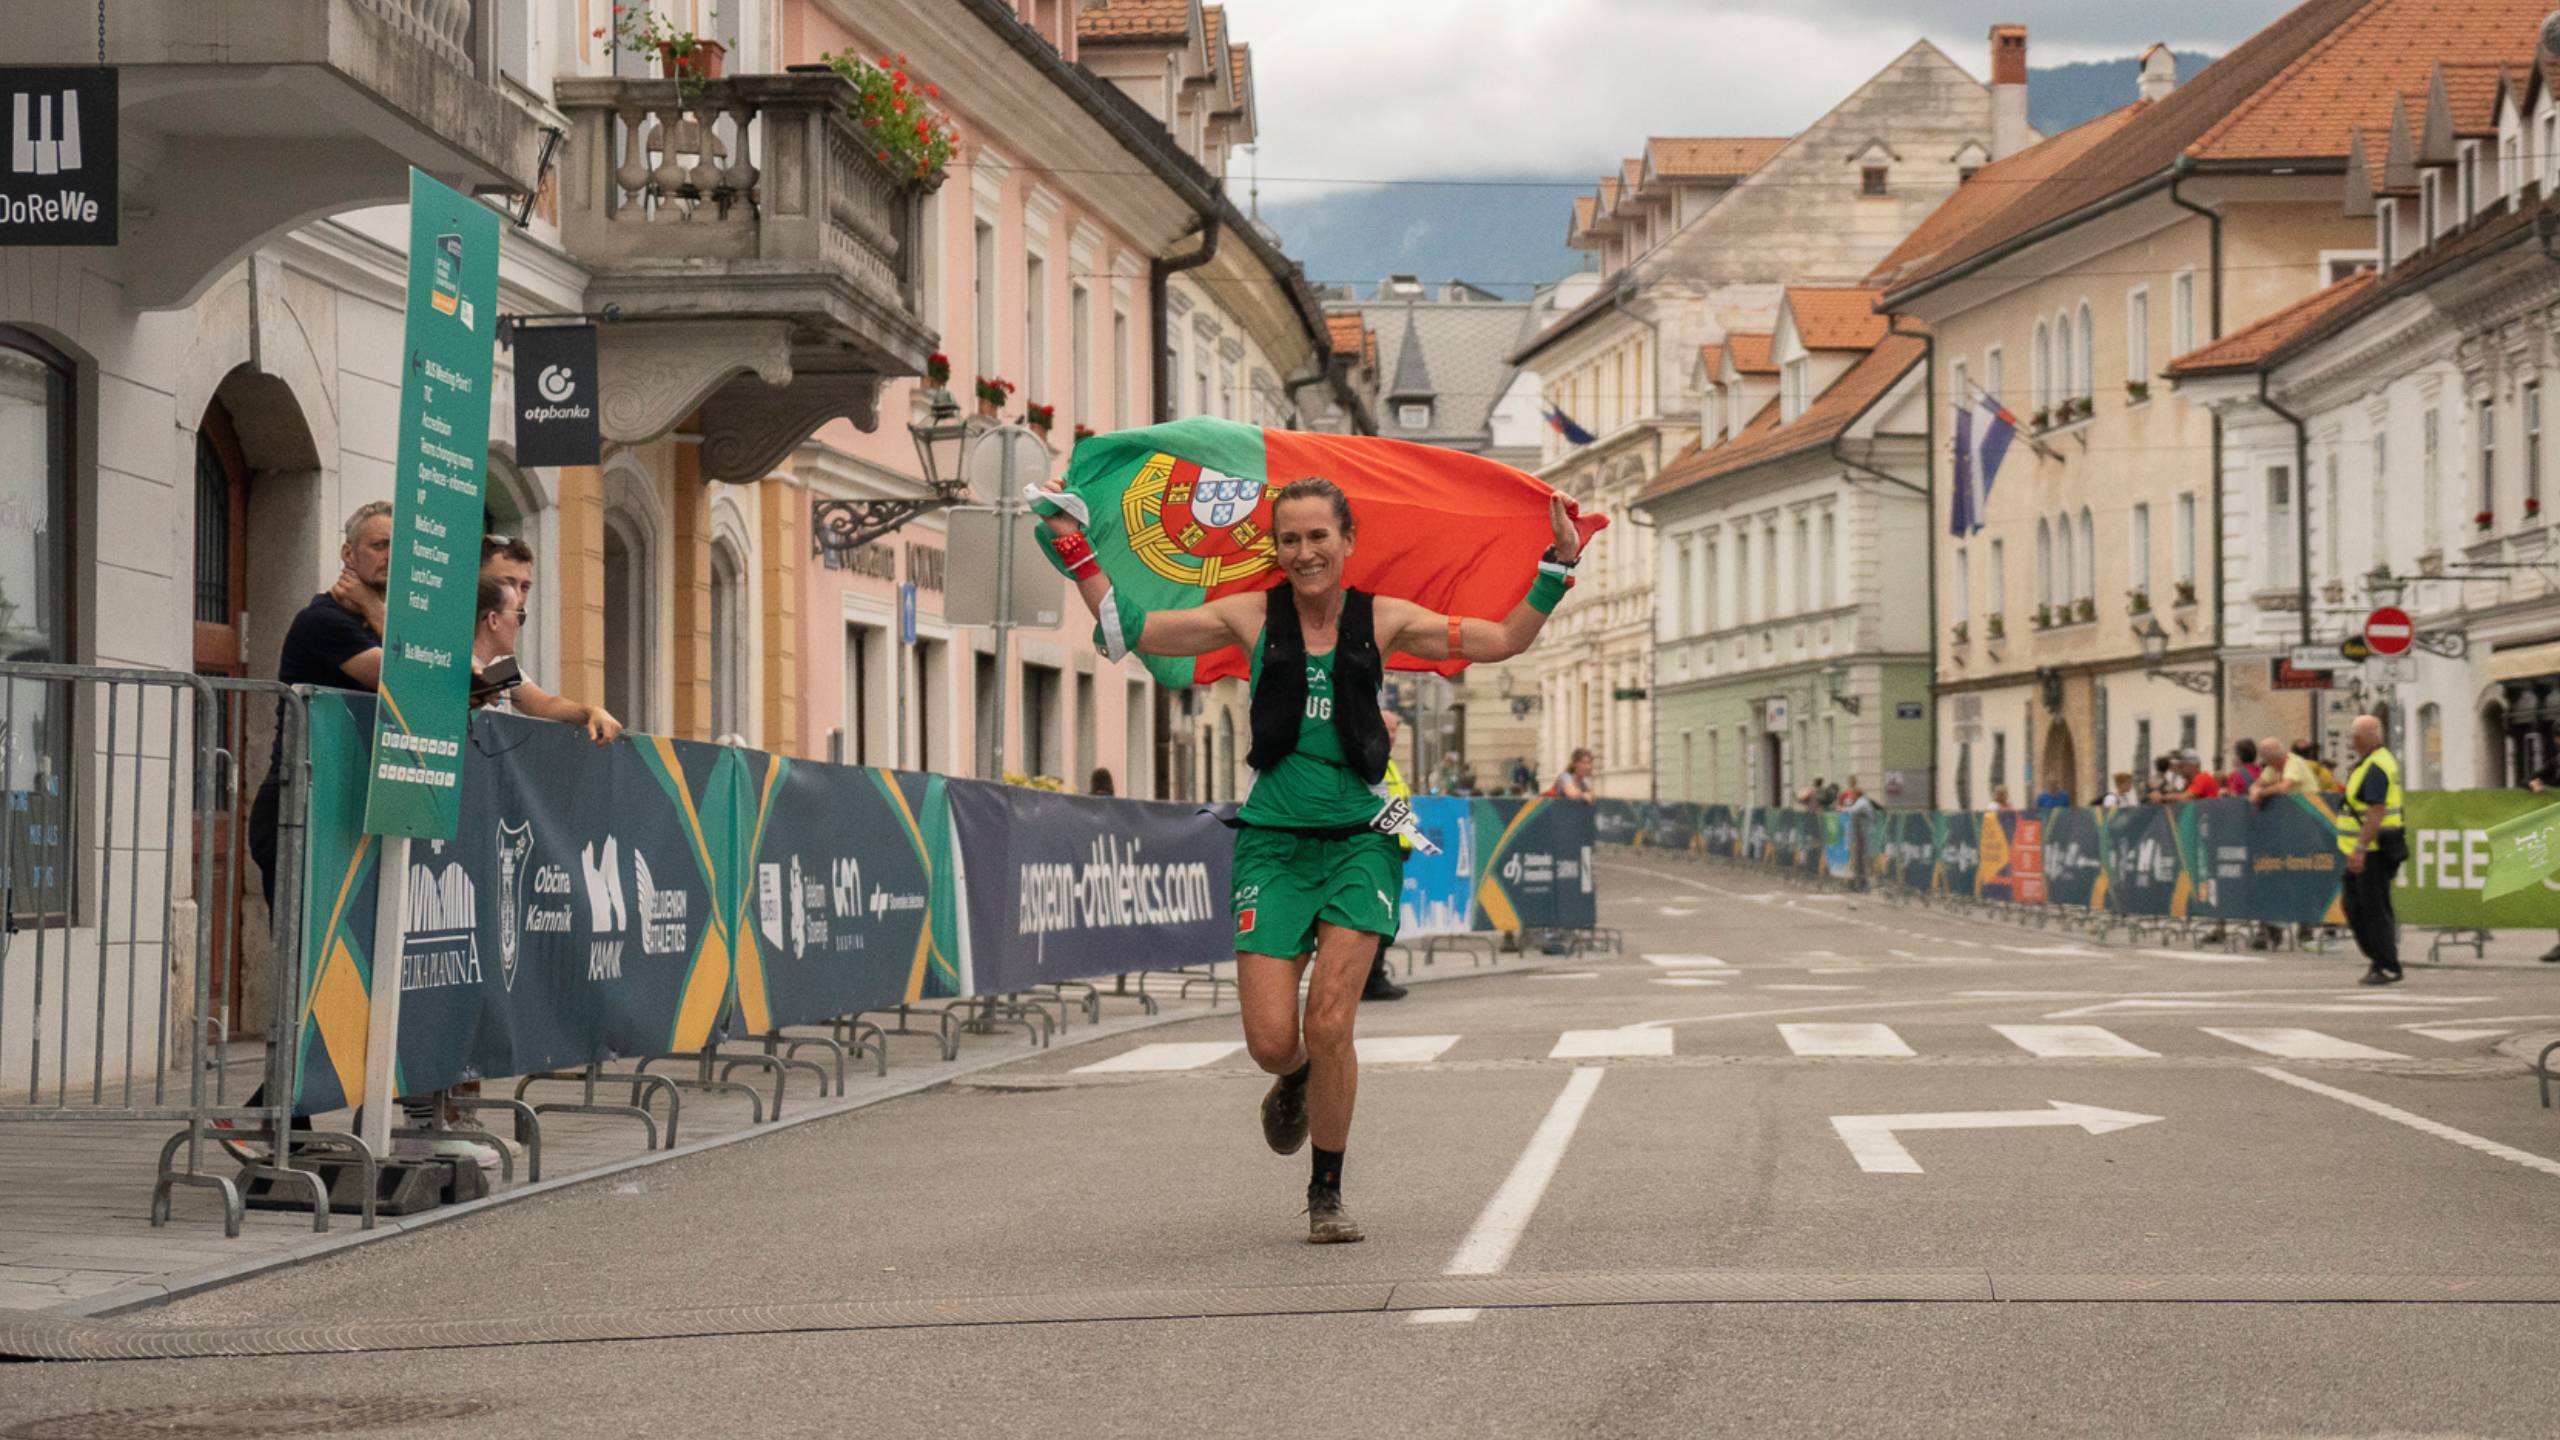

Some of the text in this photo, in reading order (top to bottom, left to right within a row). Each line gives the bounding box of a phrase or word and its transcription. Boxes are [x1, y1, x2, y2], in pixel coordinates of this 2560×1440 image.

[0, 189, 99, 224] DoReWe
[524, 404, 590, 423] otpbanka
[414, 645, 434, 669] Meeting
[434, 649, 447, 667] Point
[534, 865, 571, 894] Občina
[525, 904, 573, 932] Kamnik
